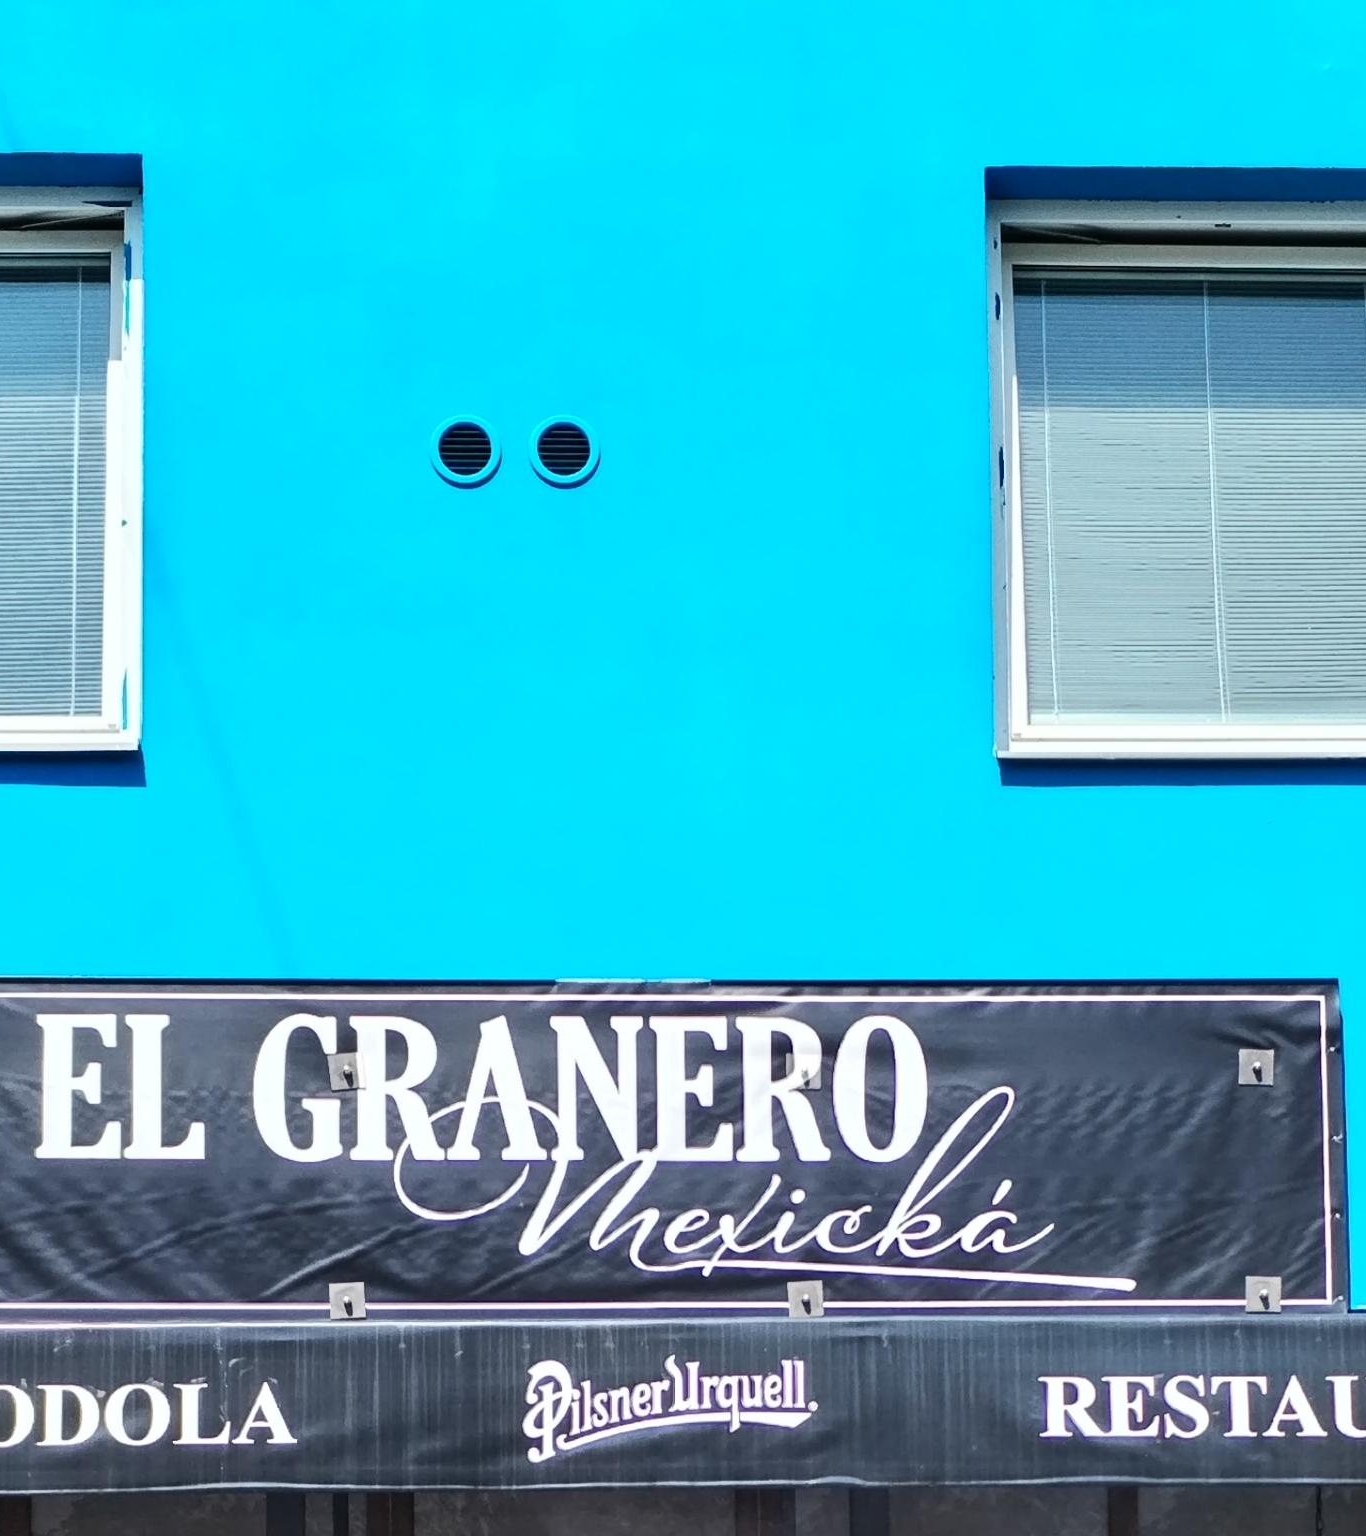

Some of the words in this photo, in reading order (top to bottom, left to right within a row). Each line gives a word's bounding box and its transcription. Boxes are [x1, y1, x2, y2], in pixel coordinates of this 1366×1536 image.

[35, 1013, 208, 1163] EL
[252, 1012, 930, 1166] GRANERO
[394, 1087, 1137, 1293] Mexická
[523, 1360, 669, 1463] Pilsner
[666, 1355, 811, 1433] Urquell
